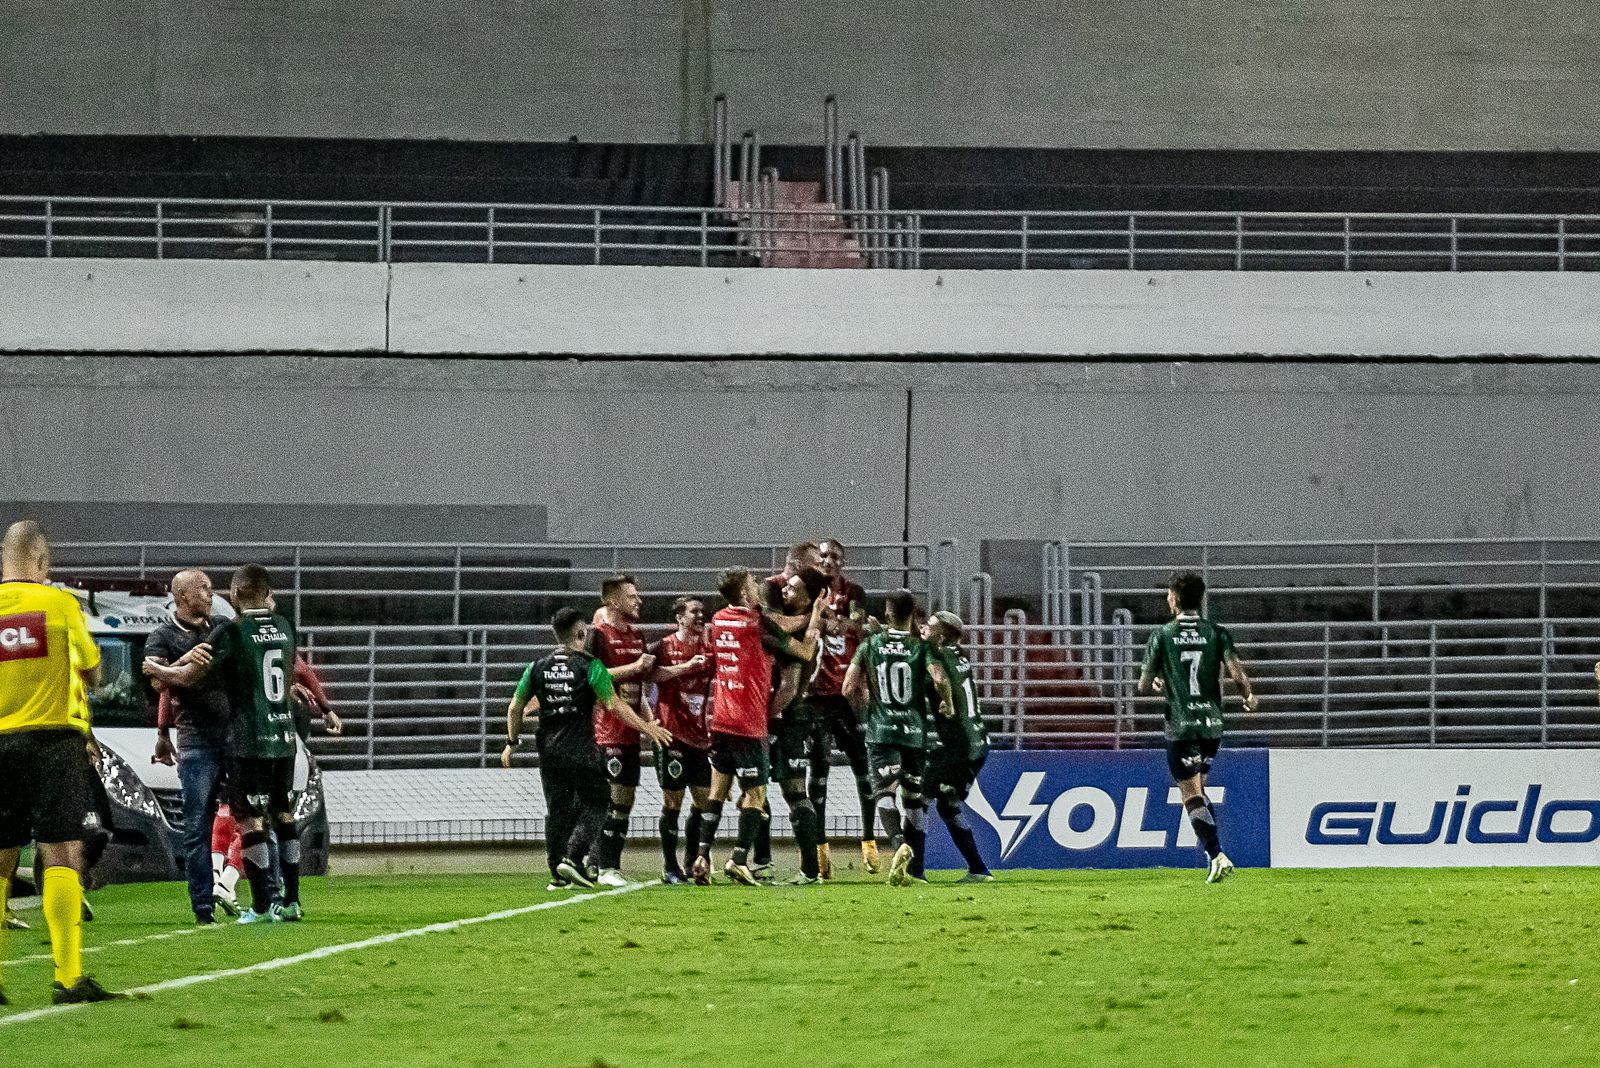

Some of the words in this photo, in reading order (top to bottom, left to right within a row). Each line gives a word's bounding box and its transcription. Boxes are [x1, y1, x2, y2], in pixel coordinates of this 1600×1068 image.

[0, 626, 36, 647] CL
[123, 615, 174, 625] PROSAU
[262, 649, 285, 702] 6
[876, 661, 912, 704] 10
[1180, 650, 1203, 696] 7
[962, 677, 977, 718] 1
[964, 771, 1225, 861] VOLT
